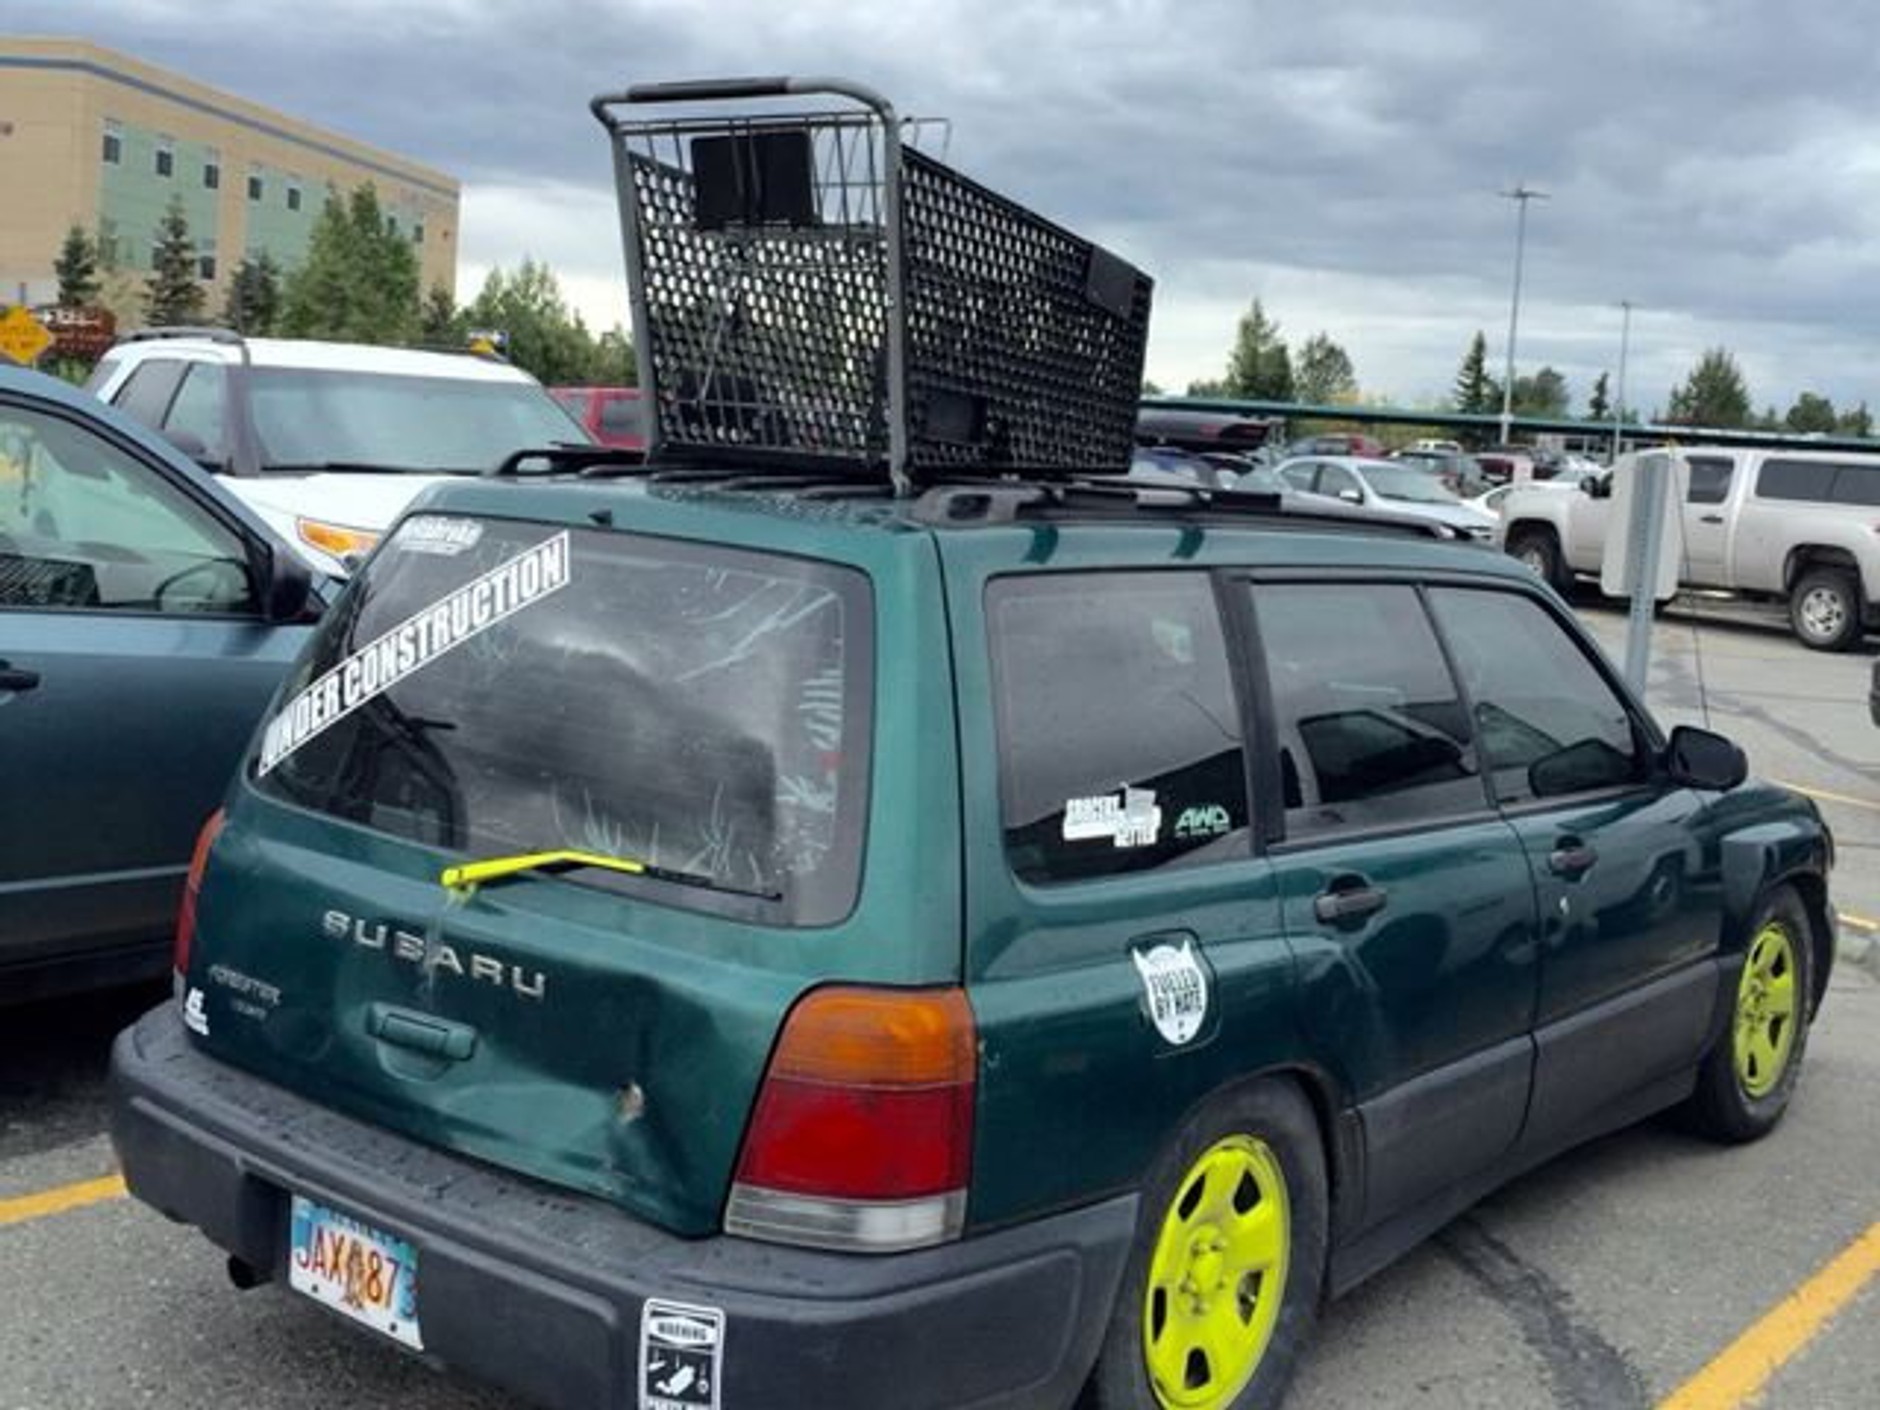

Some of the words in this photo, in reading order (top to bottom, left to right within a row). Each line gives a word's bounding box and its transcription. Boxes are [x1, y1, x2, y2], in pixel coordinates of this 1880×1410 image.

[263, 672, 341, 764] UNDER
[343, 541, 561, 707] CONSTRUCTION
[323, 909, 546, 998] SUBARU
